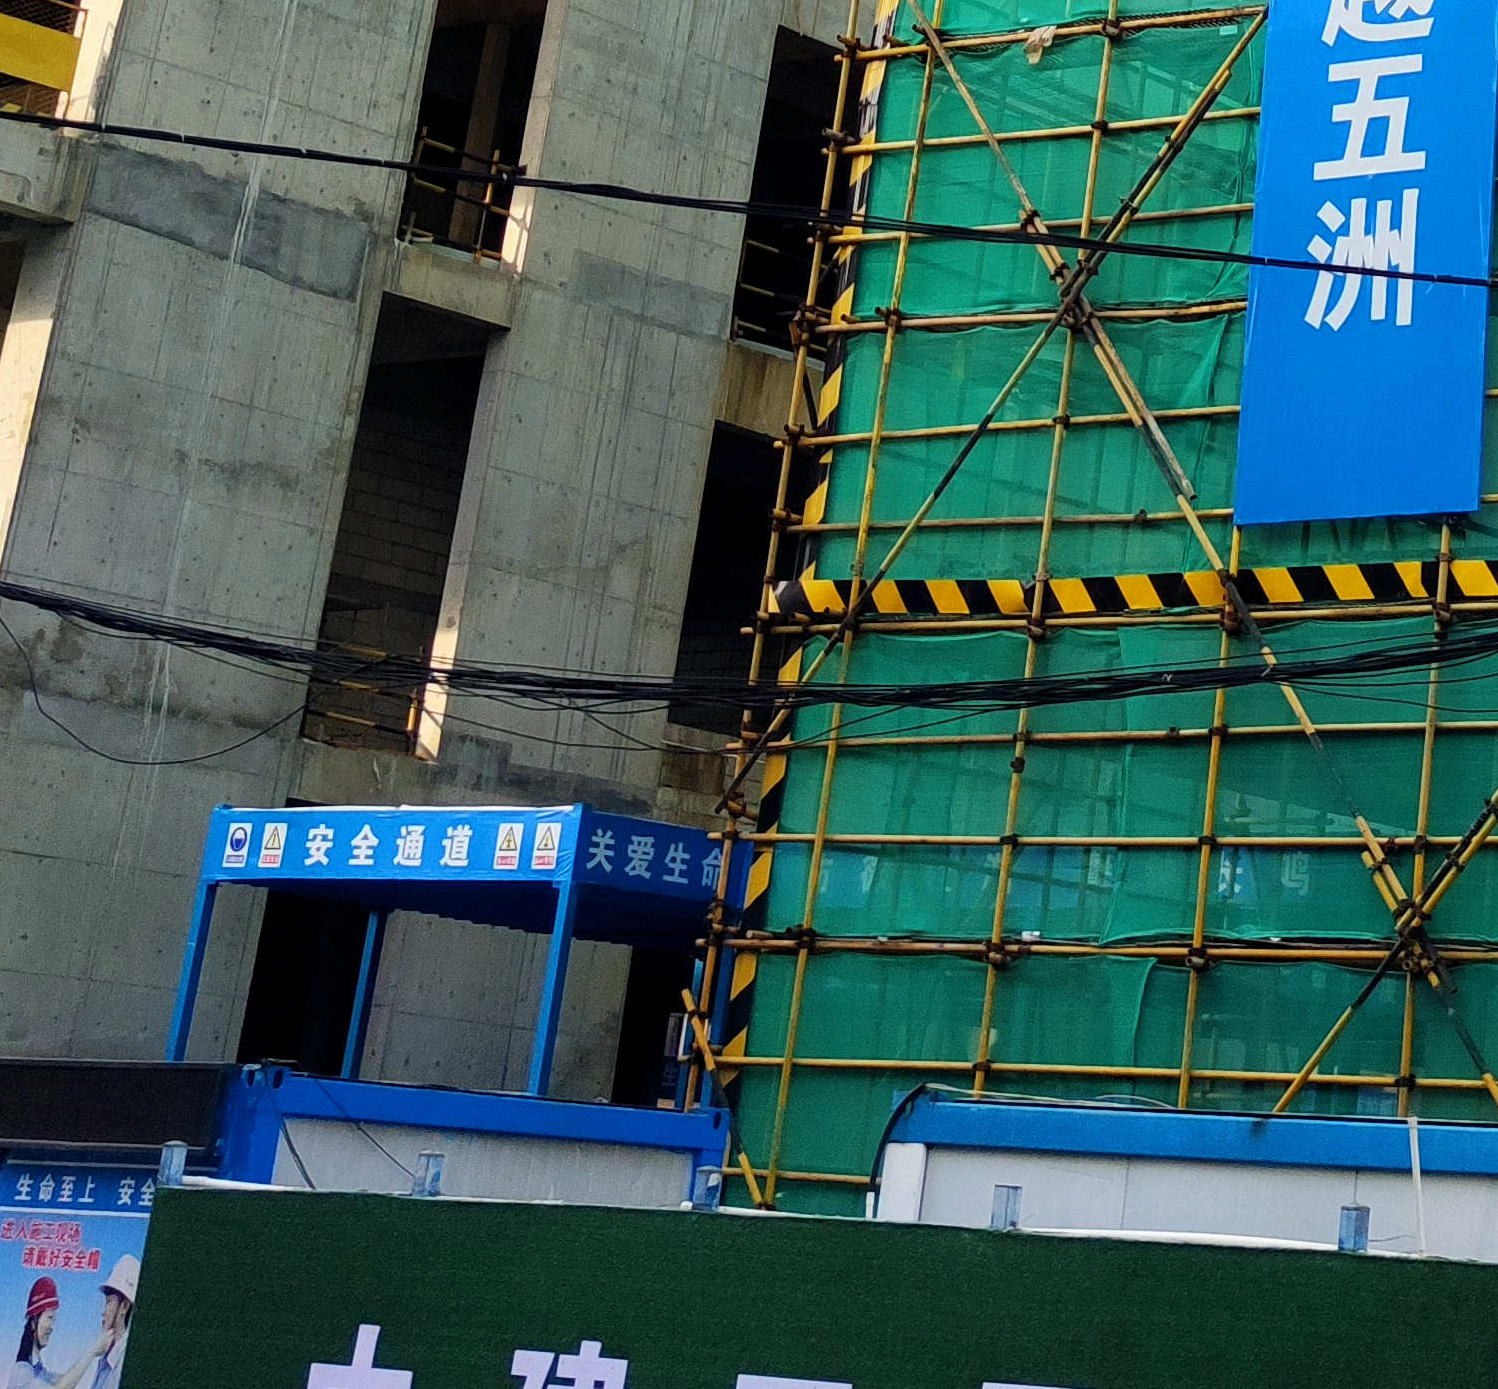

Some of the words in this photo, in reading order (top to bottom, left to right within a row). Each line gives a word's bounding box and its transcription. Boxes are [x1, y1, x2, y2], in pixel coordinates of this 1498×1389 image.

[305, 824, 470, 866] 安全通道
[588, 829, 723, 893] 关爱生命
[13, 1173, 95, 1203] 生命至上
[22, 1246, 101, 1272] 请戴好安全帽
